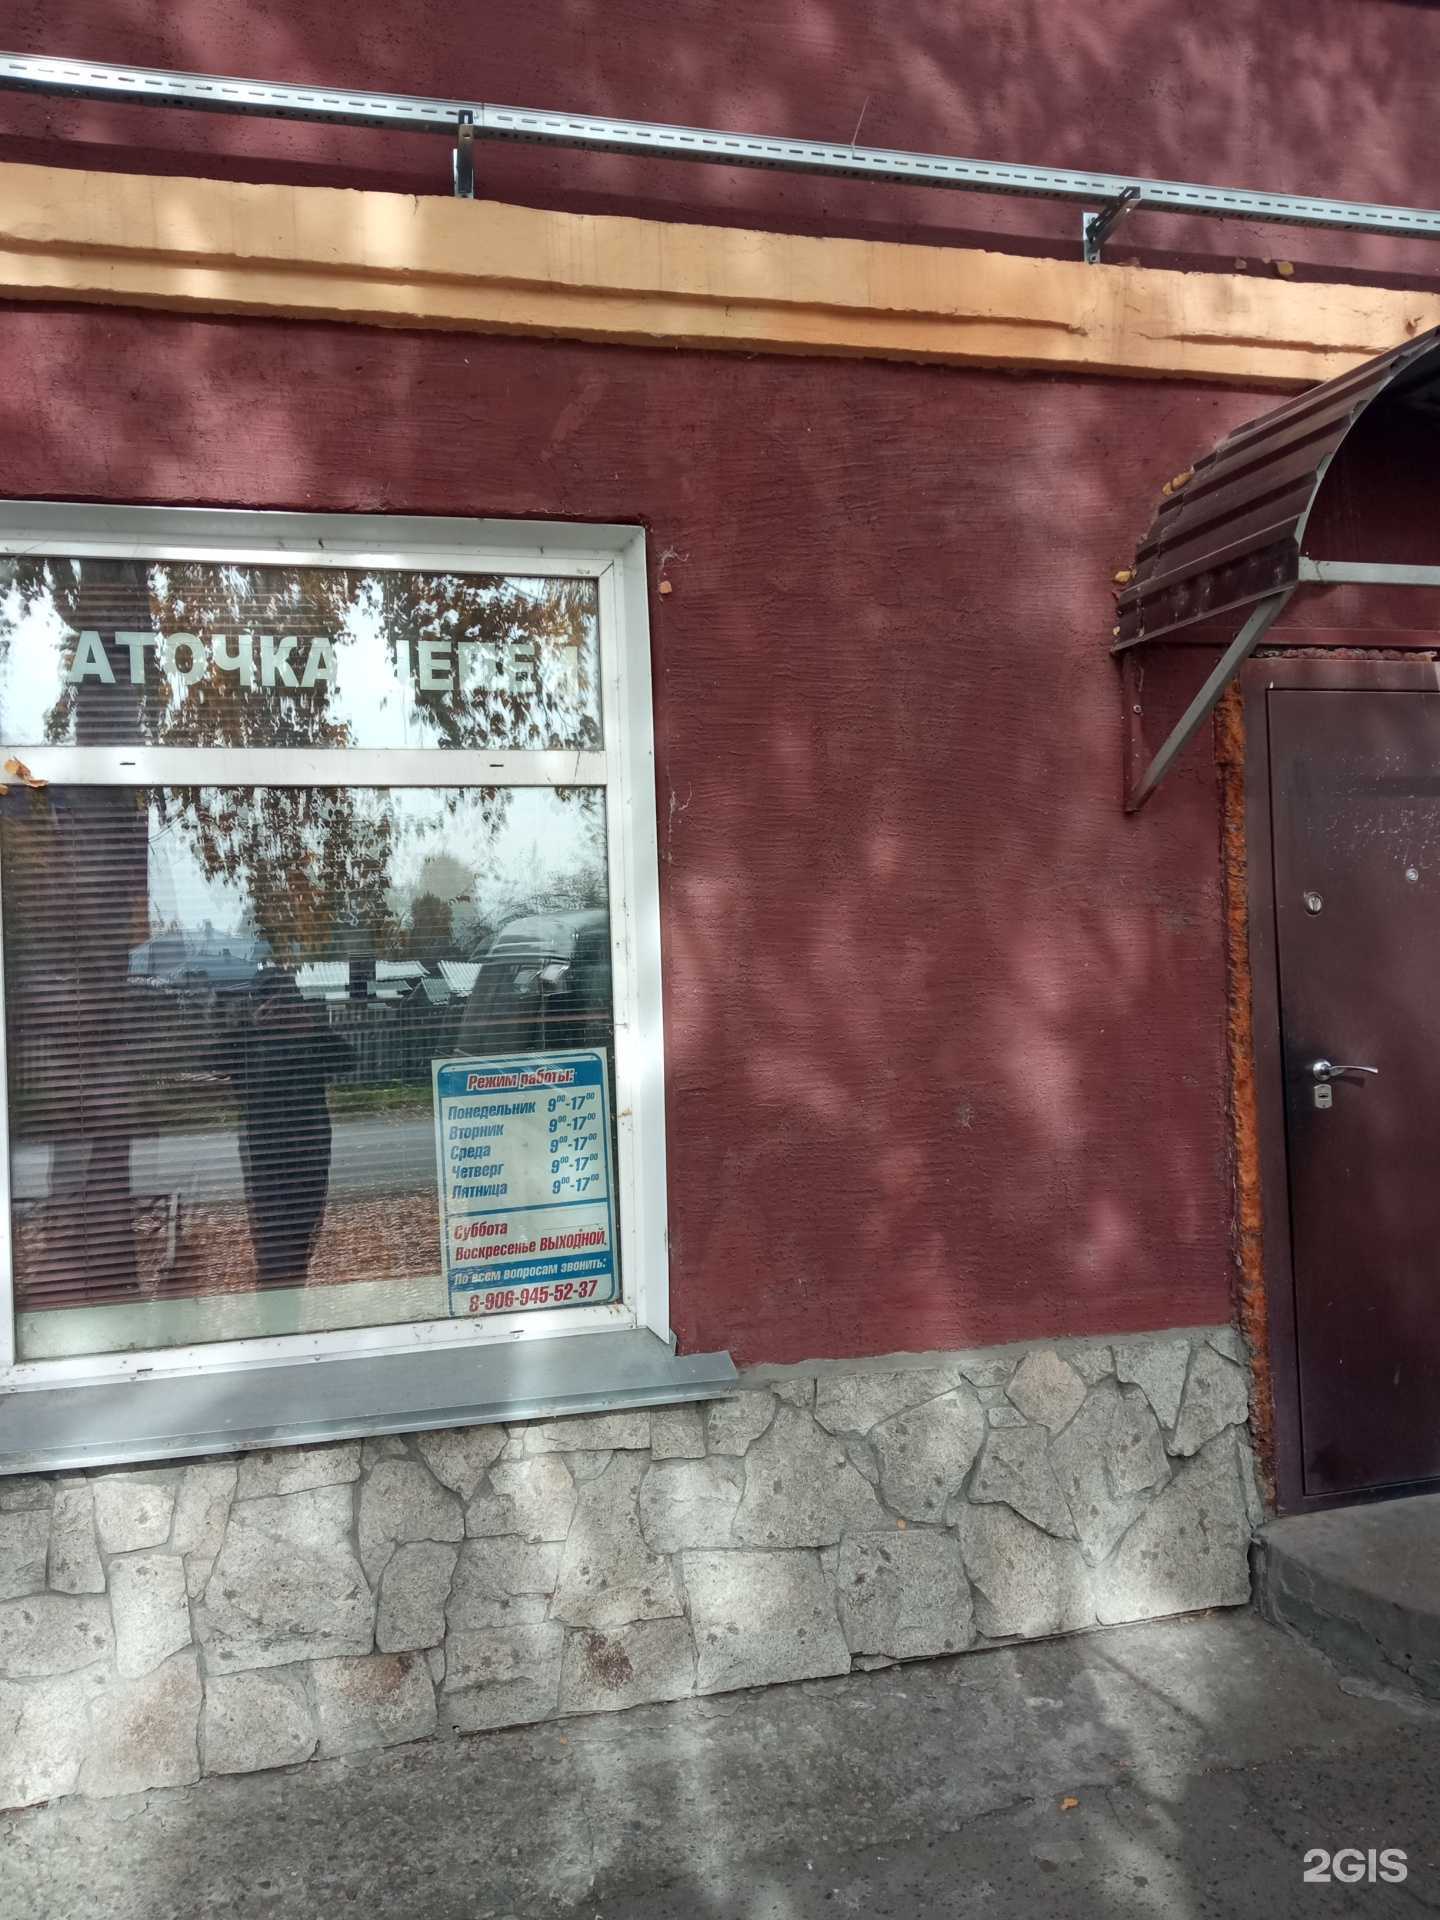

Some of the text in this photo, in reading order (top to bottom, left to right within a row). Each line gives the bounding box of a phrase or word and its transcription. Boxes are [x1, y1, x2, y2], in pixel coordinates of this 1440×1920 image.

[62, 629, 338, 689] АТОЧКА
[467, 1069, 575, 1091] Режим работы:
[448, 1101, 536, 1120] Понедельник
[449, 1124, 504, 1140] Вторник
[451, 1144, 491, 1161] Среда
[452, 1163, 504, 1179] Четверг
[452, 1183, 508, 1199] Пятница
[454, 1221, 508, 1241] Суббота
[456, 1241, 536, 1261] Воскресенье
[454, 1258, 607, 1285] По всем вопросам звонить:
[469, 1280, 598, 1312] 8-906-945-52-37
